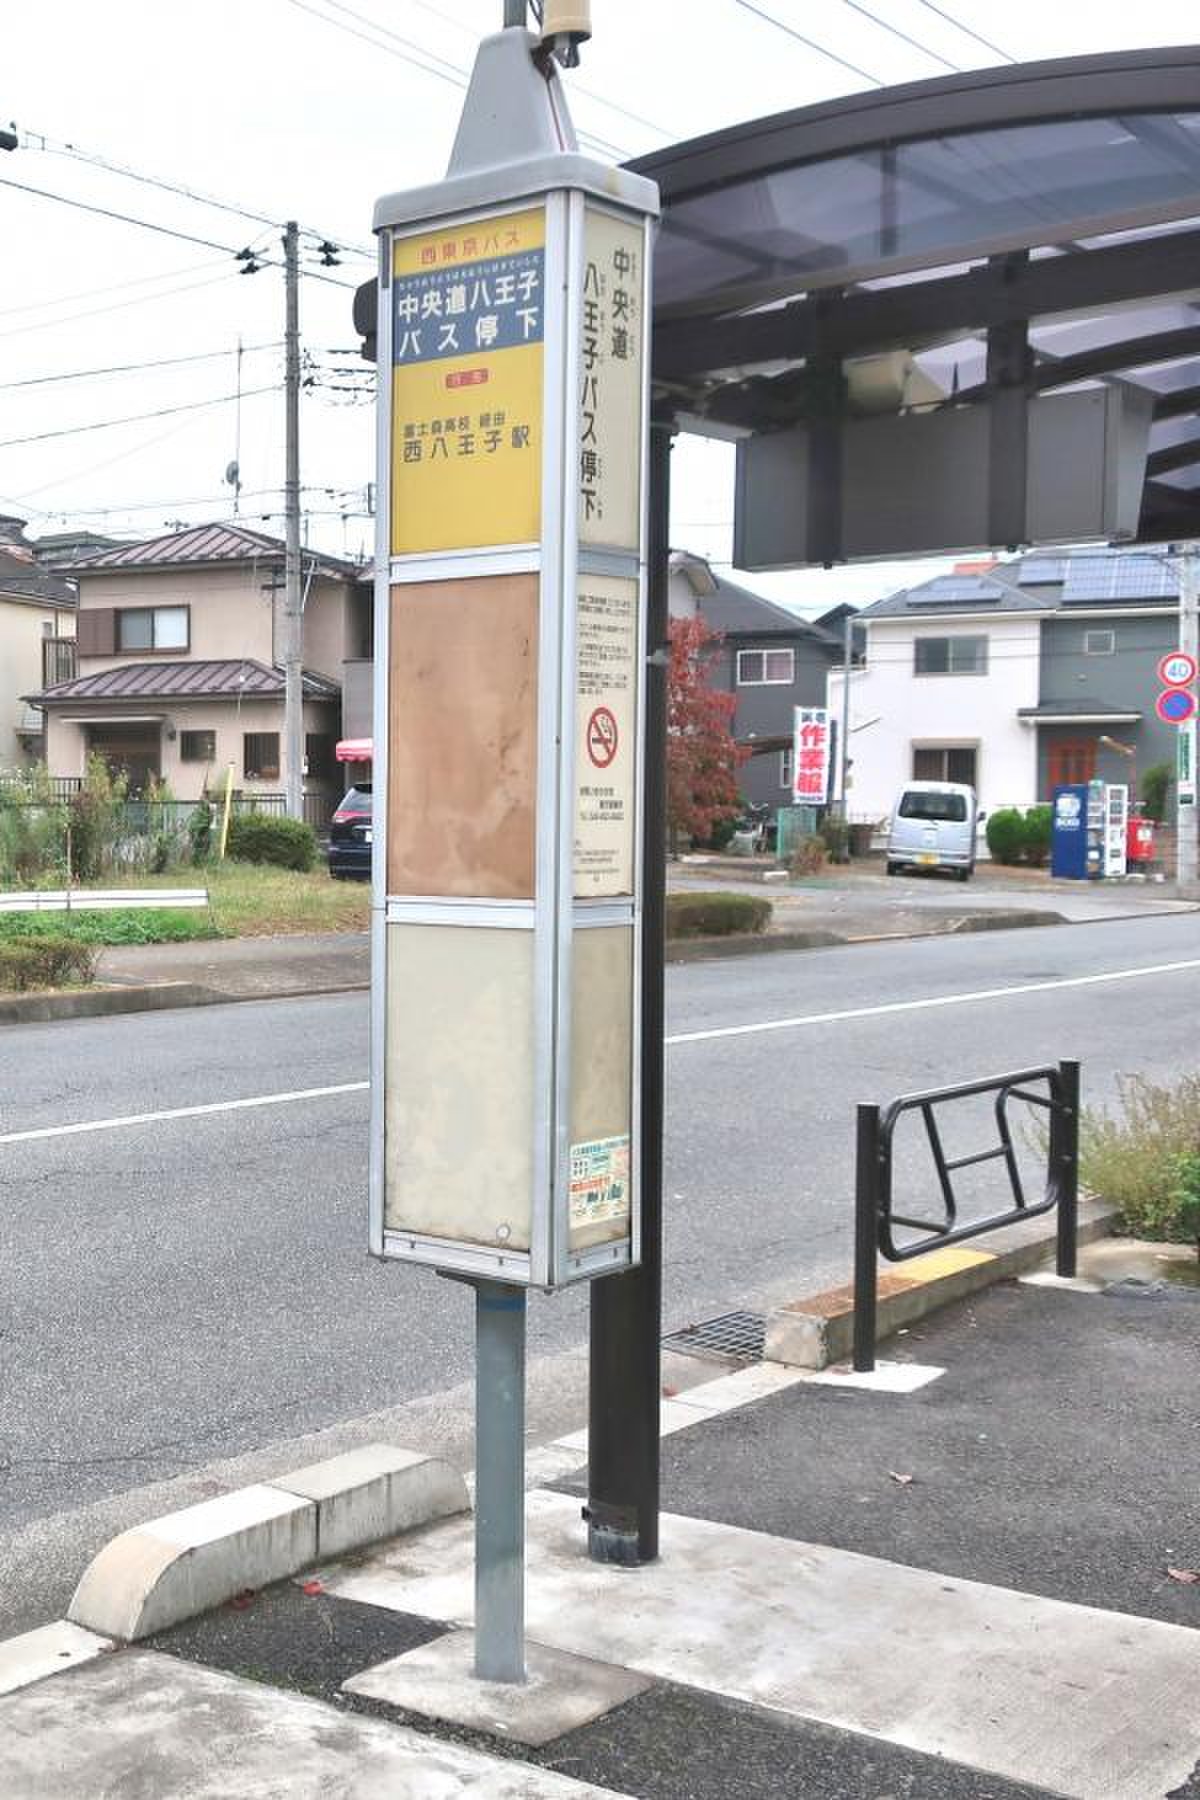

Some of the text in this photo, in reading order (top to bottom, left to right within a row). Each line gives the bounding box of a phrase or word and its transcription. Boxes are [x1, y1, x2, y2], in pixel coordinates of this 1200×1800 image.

[399, 270, 539, 324] 中央道八王子
[611, 246, 630, 360] 中央道
[399, 306, 539, 358] バス停下
[580, 261, 599, 521] 八王子バス停下
[403, 425, 530, 464] 西八王子駅
[1167, 662, 1189, 677] 40
